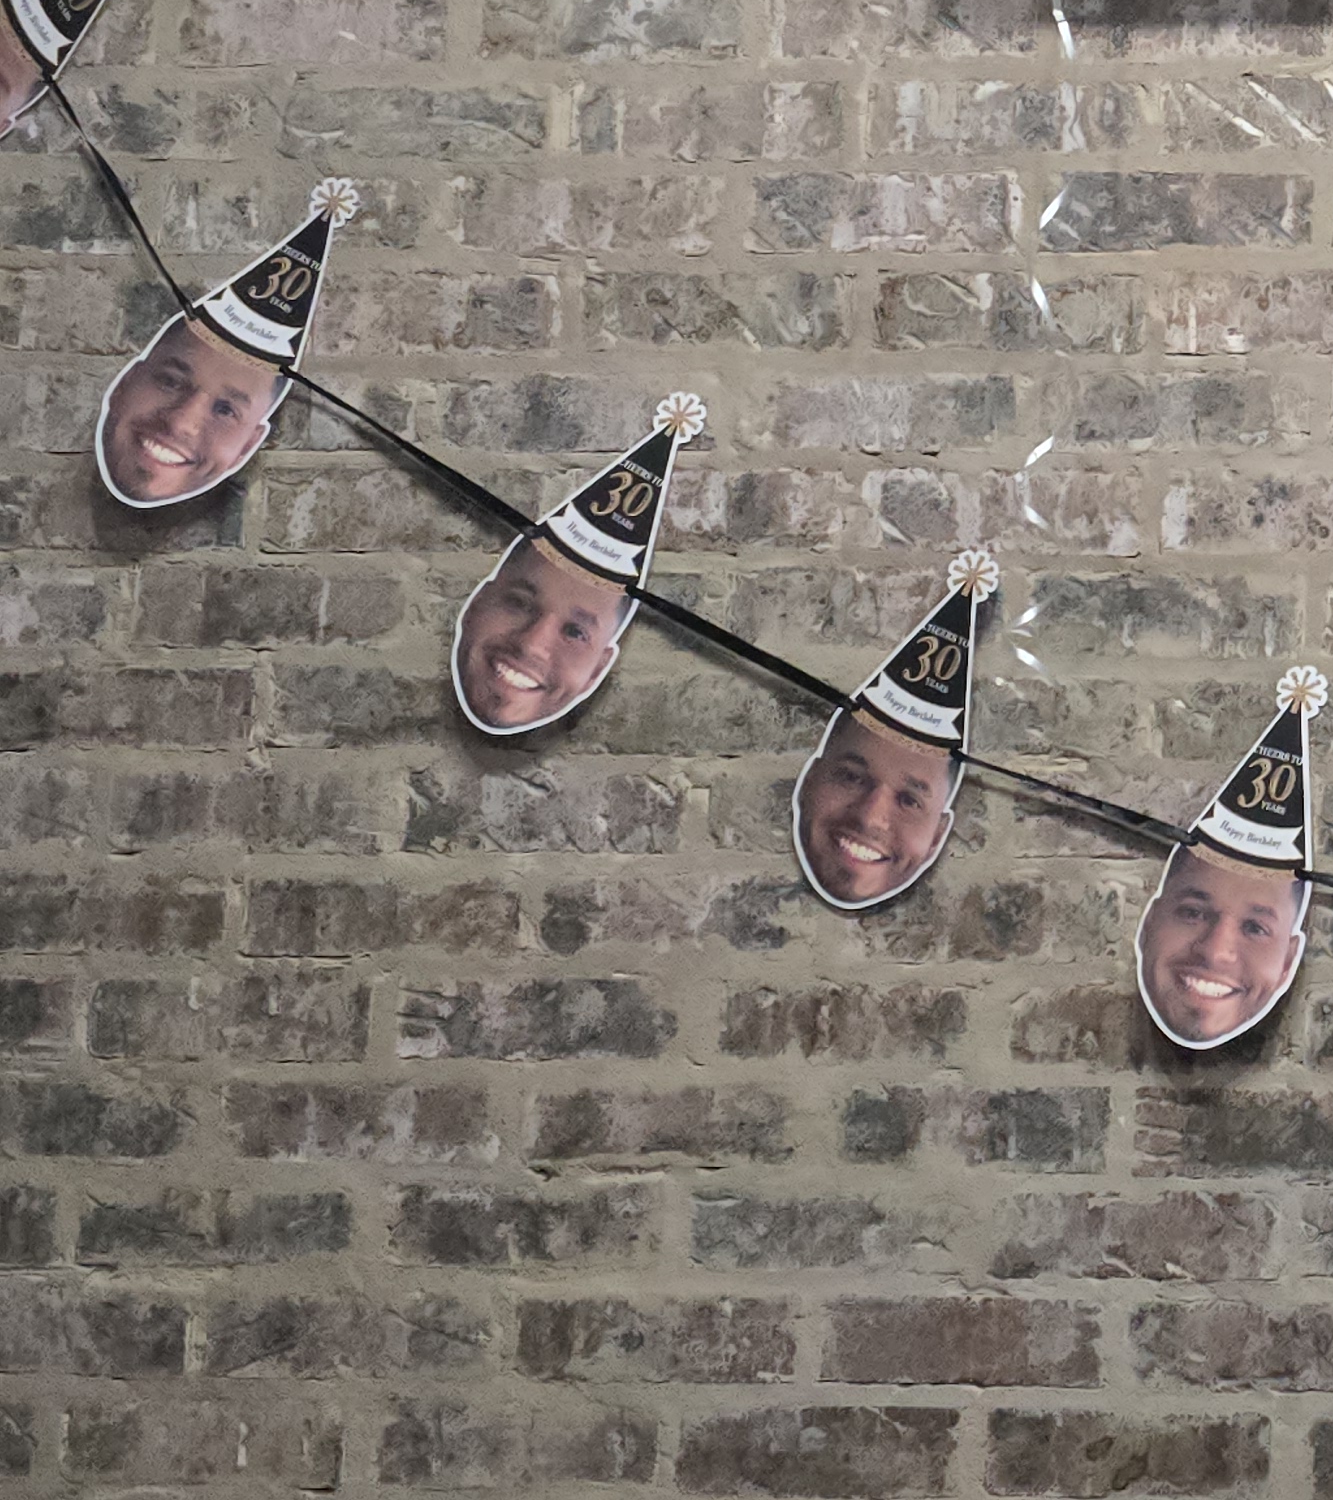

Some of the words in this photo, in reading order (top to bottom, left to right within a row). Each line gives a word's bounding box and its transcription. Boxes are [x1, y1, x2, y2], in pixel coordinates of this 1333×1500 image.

[247, 256, 312, 301] 30
[224, 304, 246, 328] Happy
[244, 321, 279, 341] Birthday
[589, 471, 653, 517] 30
[566, 521, 589, 545] Happy
[588, 539, 622, 562] Birthday
[902, 635, 961, 683] 30
[883, 690, 907, 714] Happy
[907, 706, 943, 727] Birthday
[1237, 757, 1297, 808] 30
[1219, 820, 1245, 841] Happy
[1246, 832, 1282, 850] Birthday
